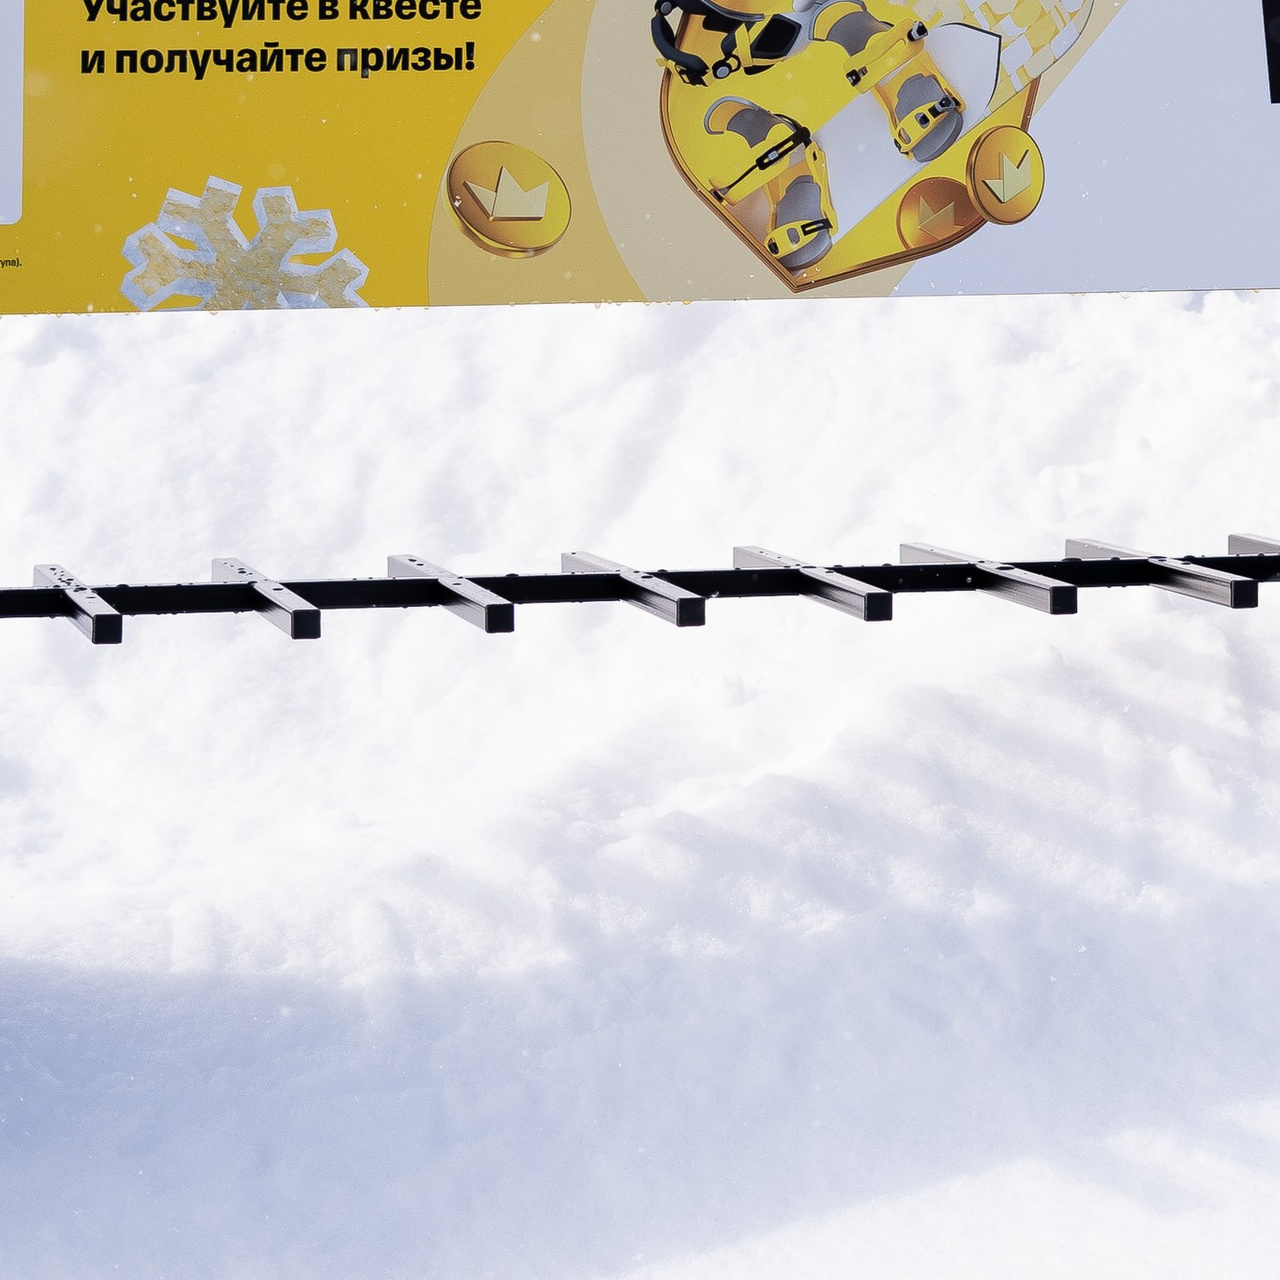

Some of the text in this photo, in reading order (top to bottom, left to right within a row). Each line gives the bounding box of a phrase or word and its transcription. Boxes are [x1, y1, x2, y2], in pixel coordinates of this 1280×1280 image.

[81, 41, 476, 80] и получайте призы!
[0, 257, 22, 268] упа).
